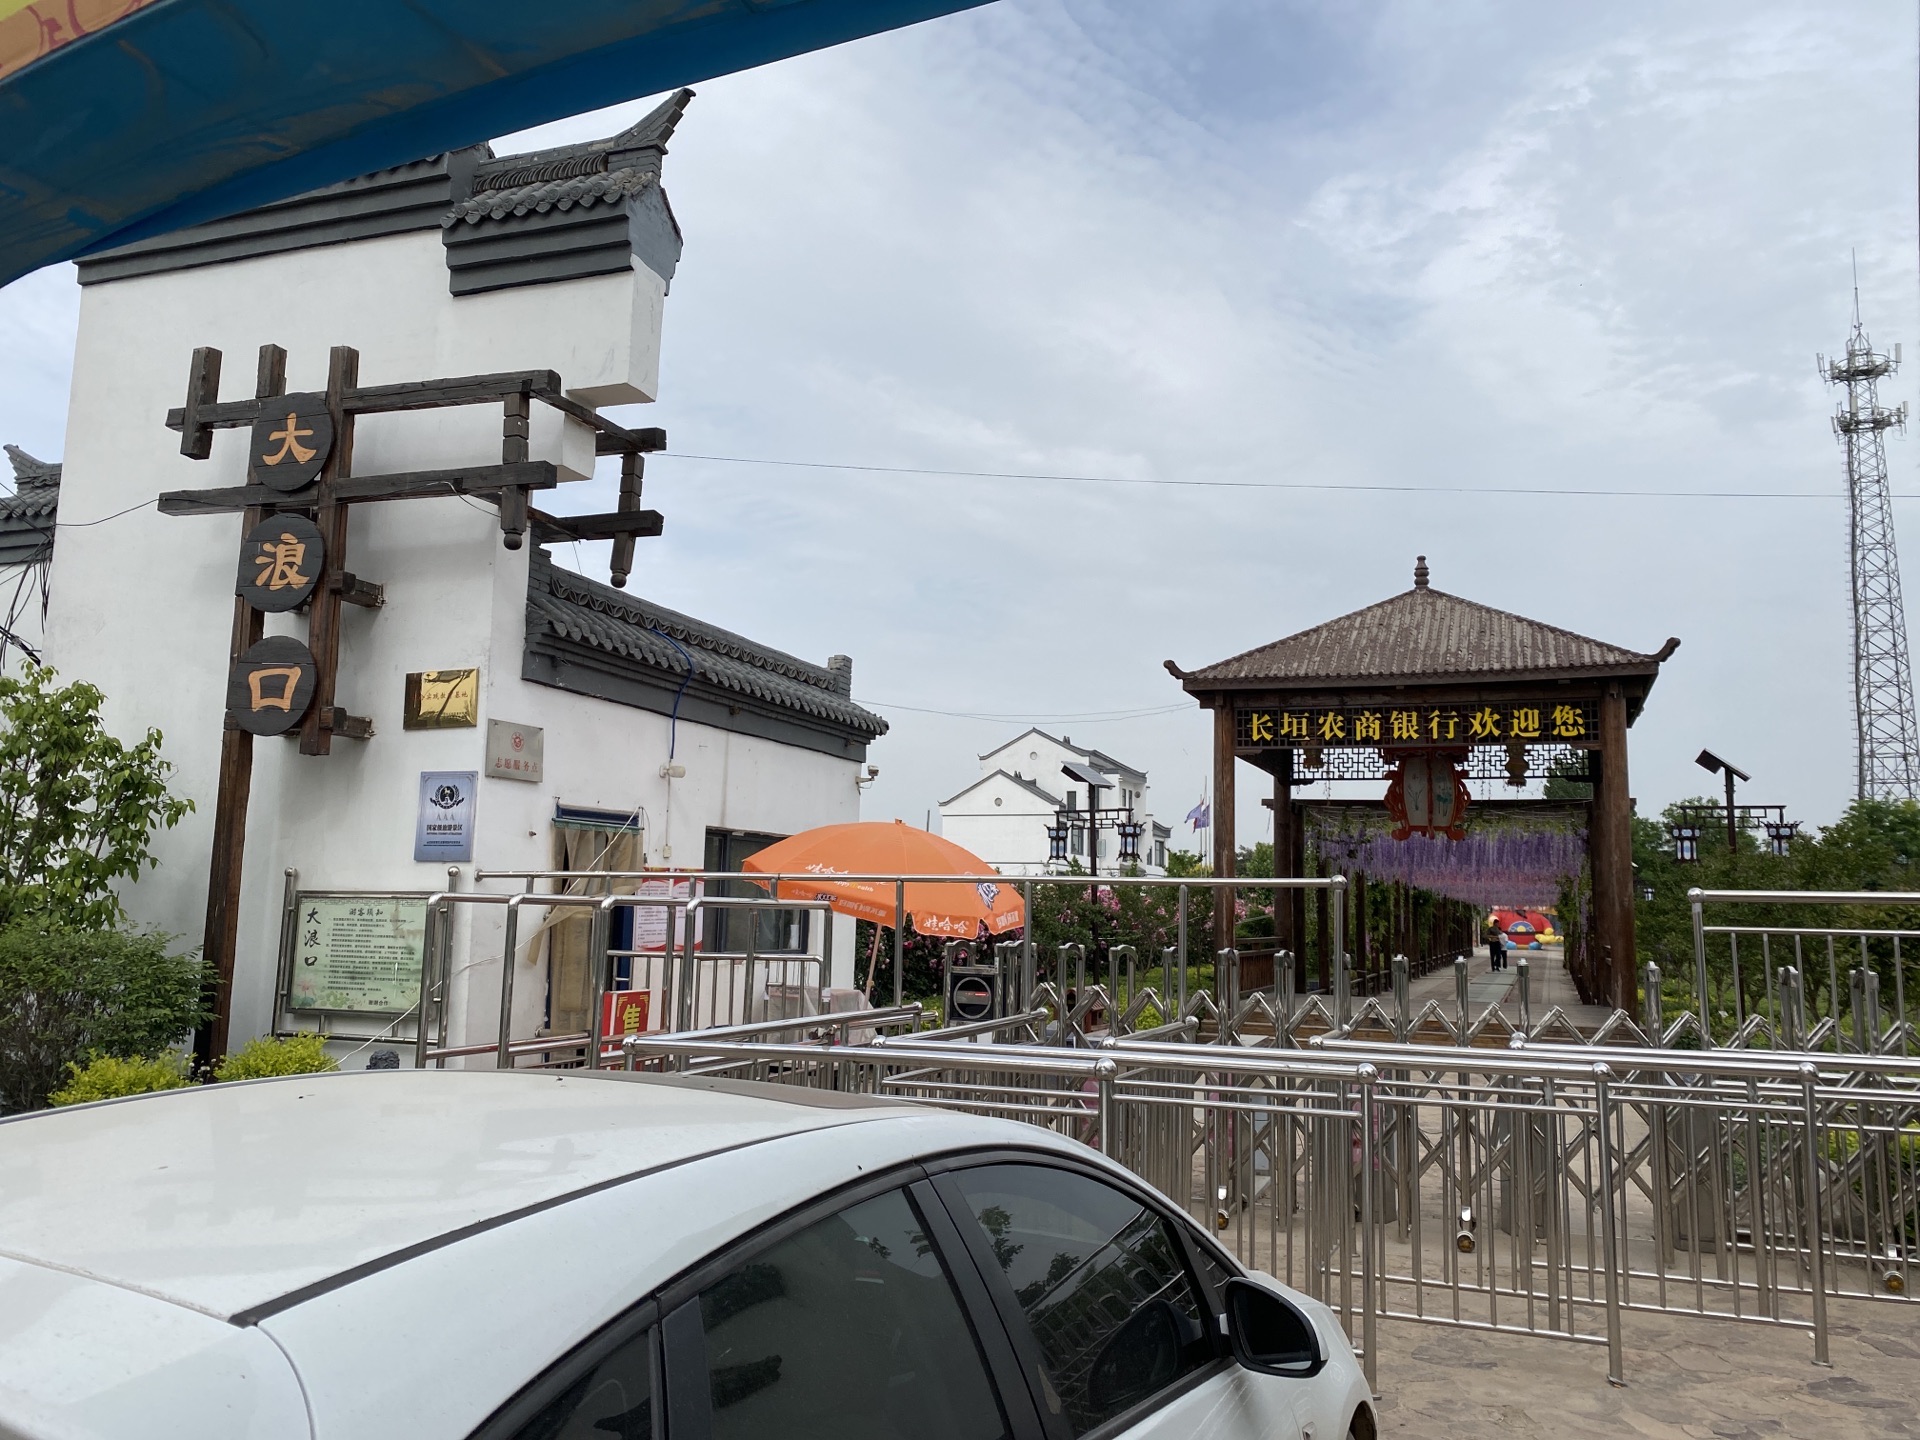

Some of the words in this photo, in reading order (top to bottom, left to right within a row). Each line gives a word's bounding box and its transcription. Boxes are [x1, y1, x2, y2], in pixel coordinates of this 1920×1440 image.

[247, 411, 317, 713] 大浪口
[1250, 704, 1586, 742] 长垣农商银行欢迎您
[495, 756, 539, 773] 志愿服务点
[349, 907, 383, 917] 游客须知
[923, 914, 968, 934] 娃哈哈
[304, 907, 322, 967] 大浪口
